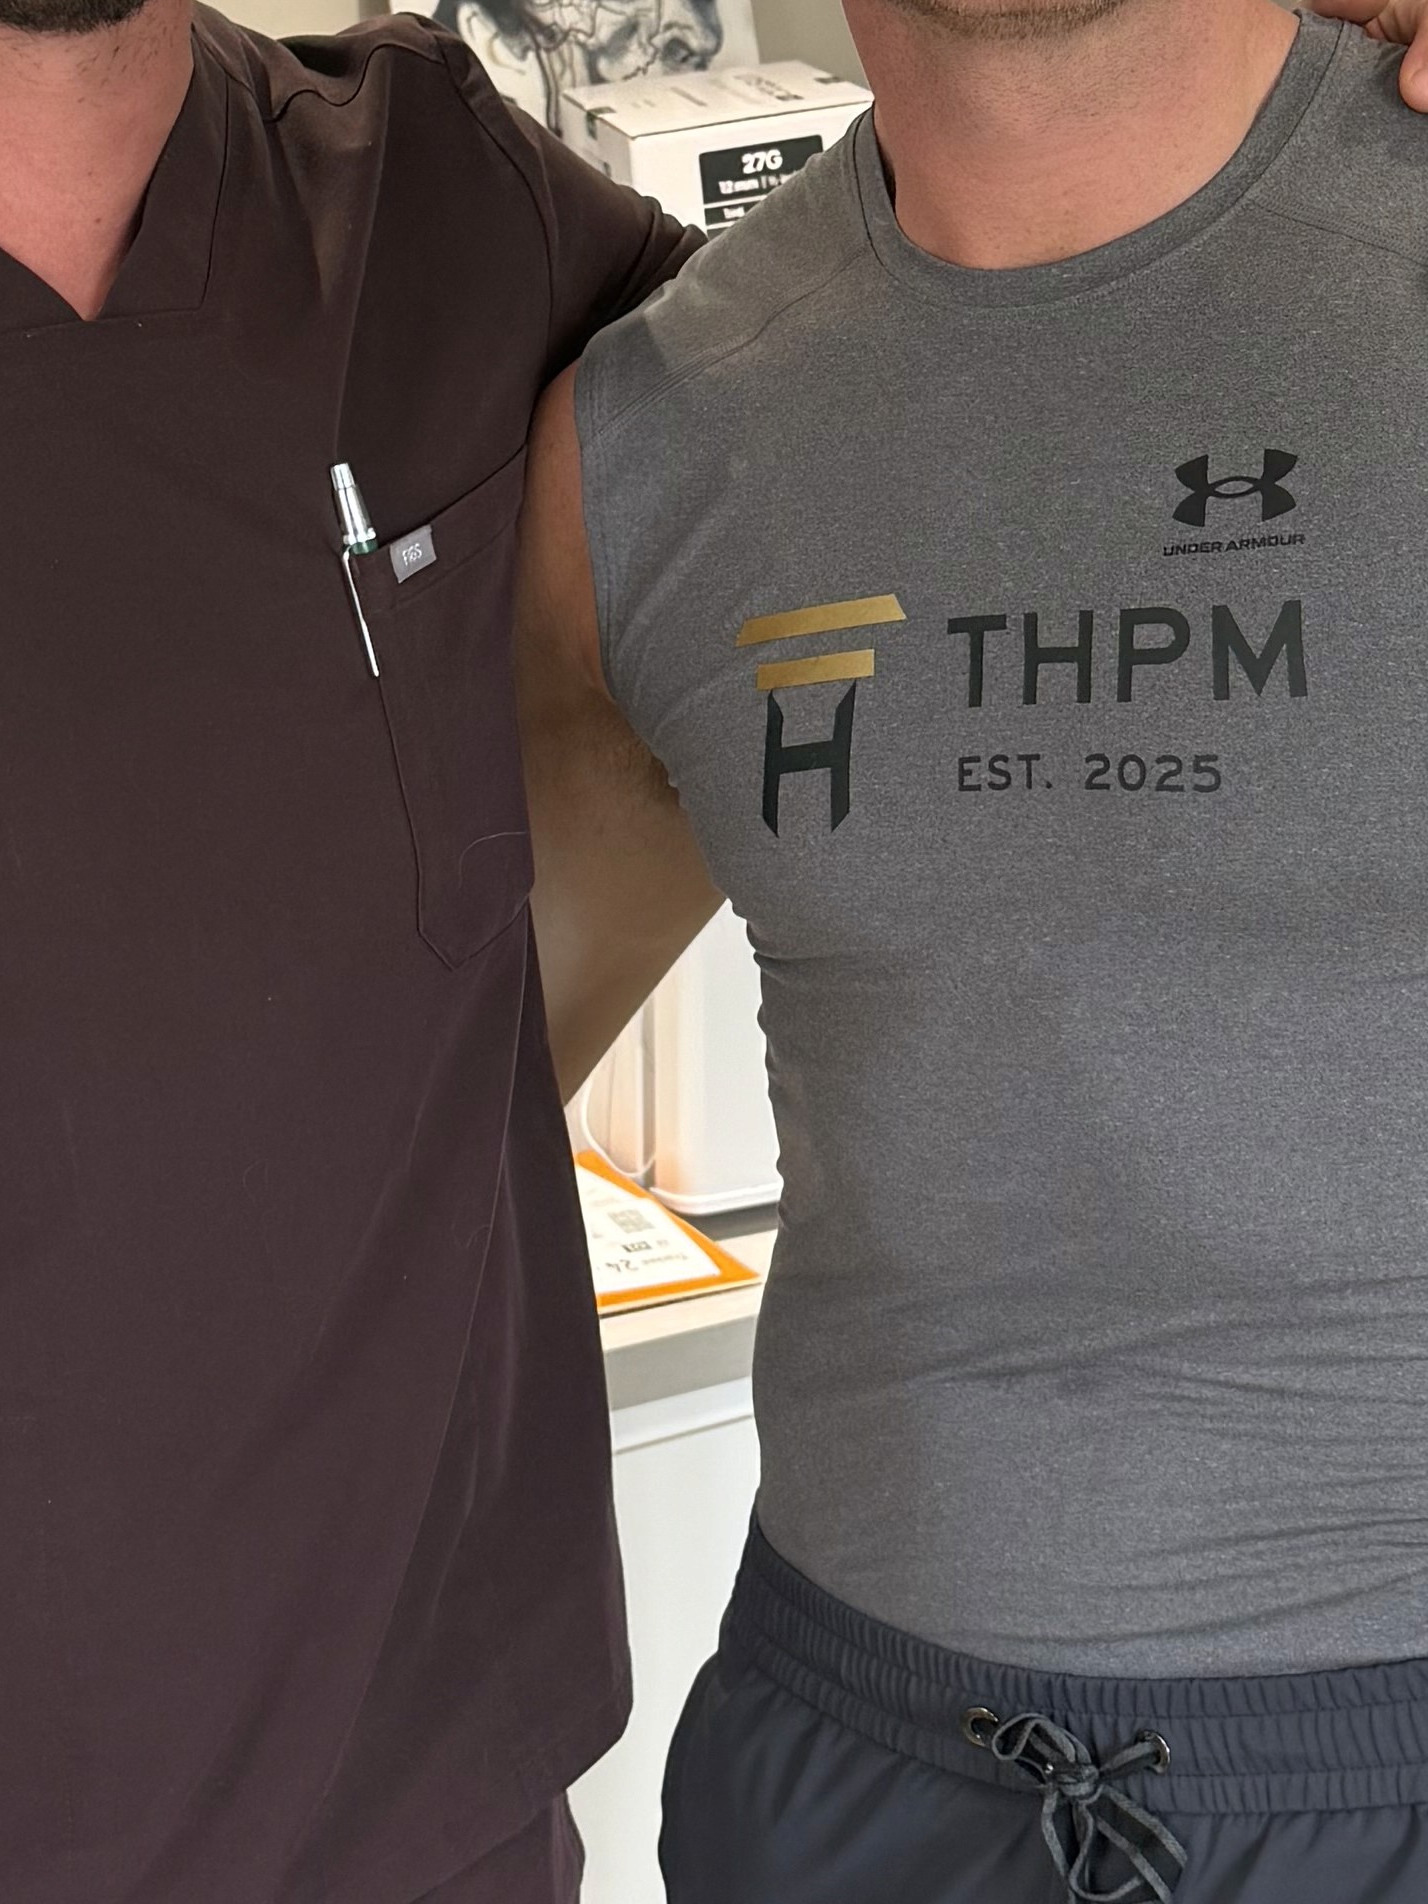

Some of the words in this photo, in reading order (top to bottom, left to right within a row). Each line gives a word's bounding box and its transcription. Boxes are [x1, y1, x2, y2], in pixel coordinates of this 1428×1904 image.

[741, 149, 783, 174] 27G
[1163, 541, 1223, 556] UNDER
[1225, 534, 1306, 552] ARMOUR
[947, 599, 1308, 708] THPM
[957, 753, 1053, 793] EST.
[1084, 754, 1222, 794] 2025
